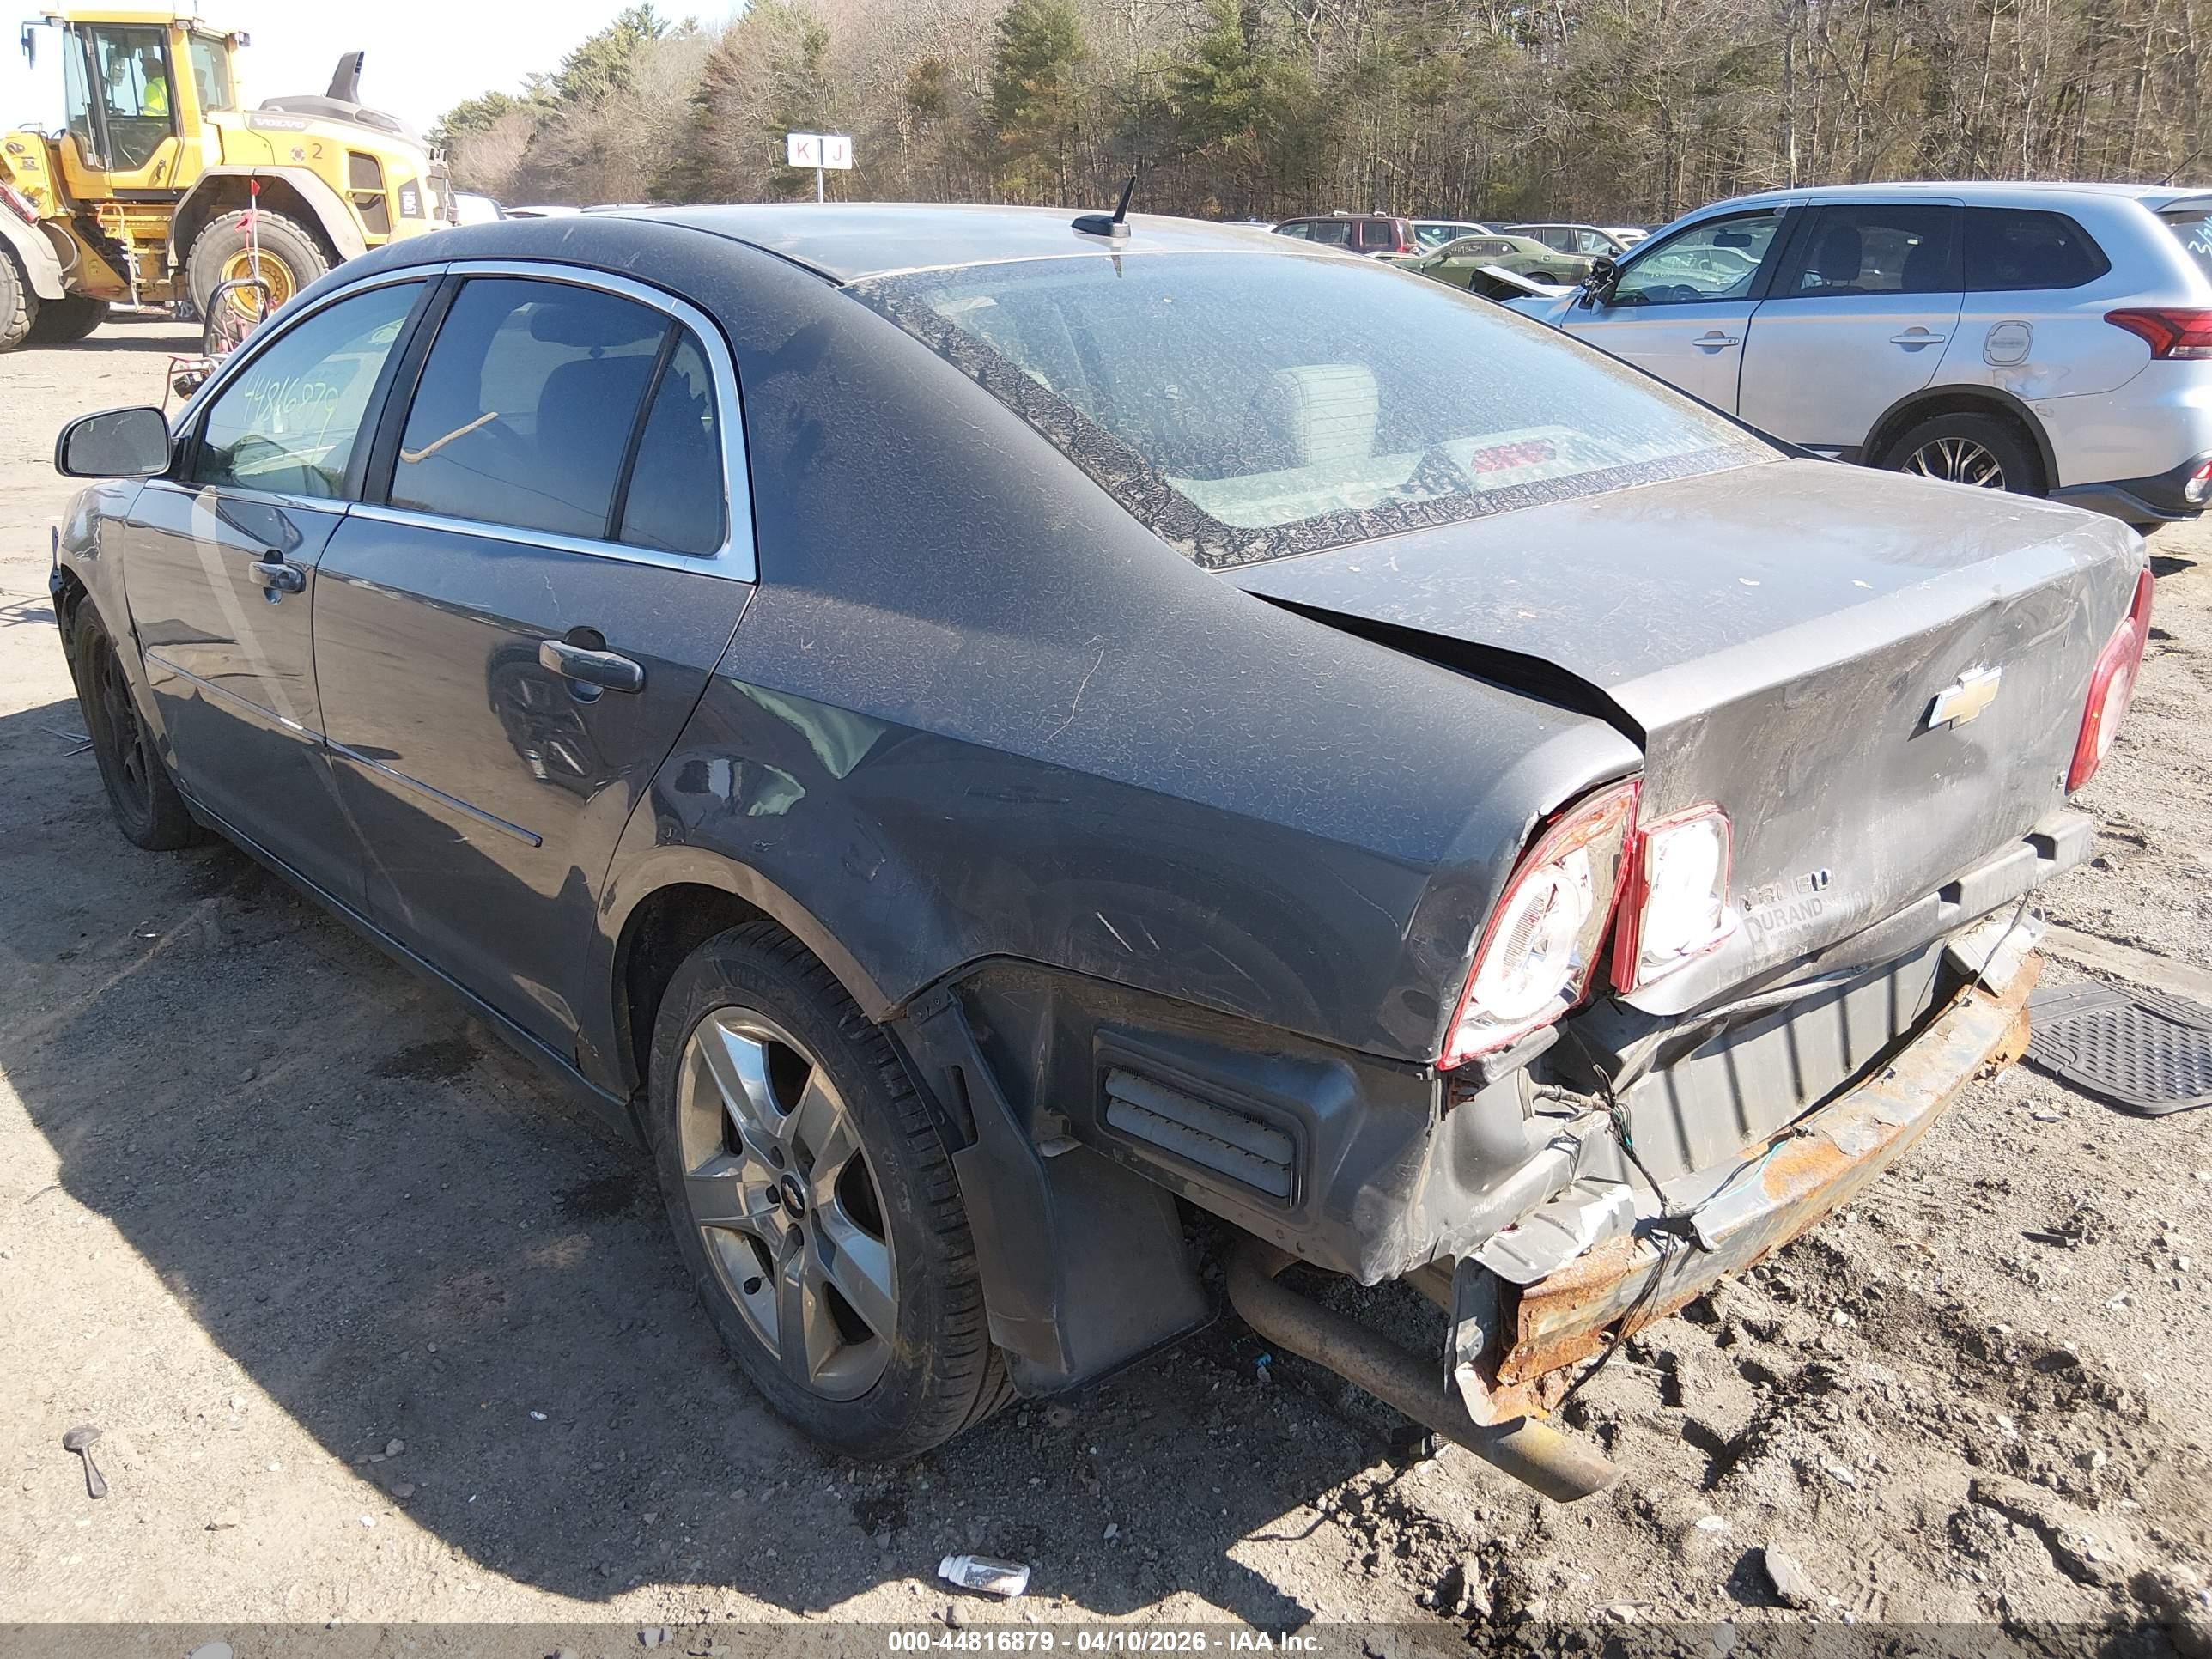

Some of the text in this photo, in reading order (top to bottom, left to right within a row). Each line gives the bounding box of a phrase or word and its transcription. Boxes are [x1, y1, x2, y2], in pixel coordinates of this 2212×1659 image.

[254, 118, 306, 129] VOLVO
[312, 143, 323, 160] 2
[797, 142, 842, 161] K J
[244, 371, 338, 445] 44816879
[1743, 897, 1823, 945] DURAND
